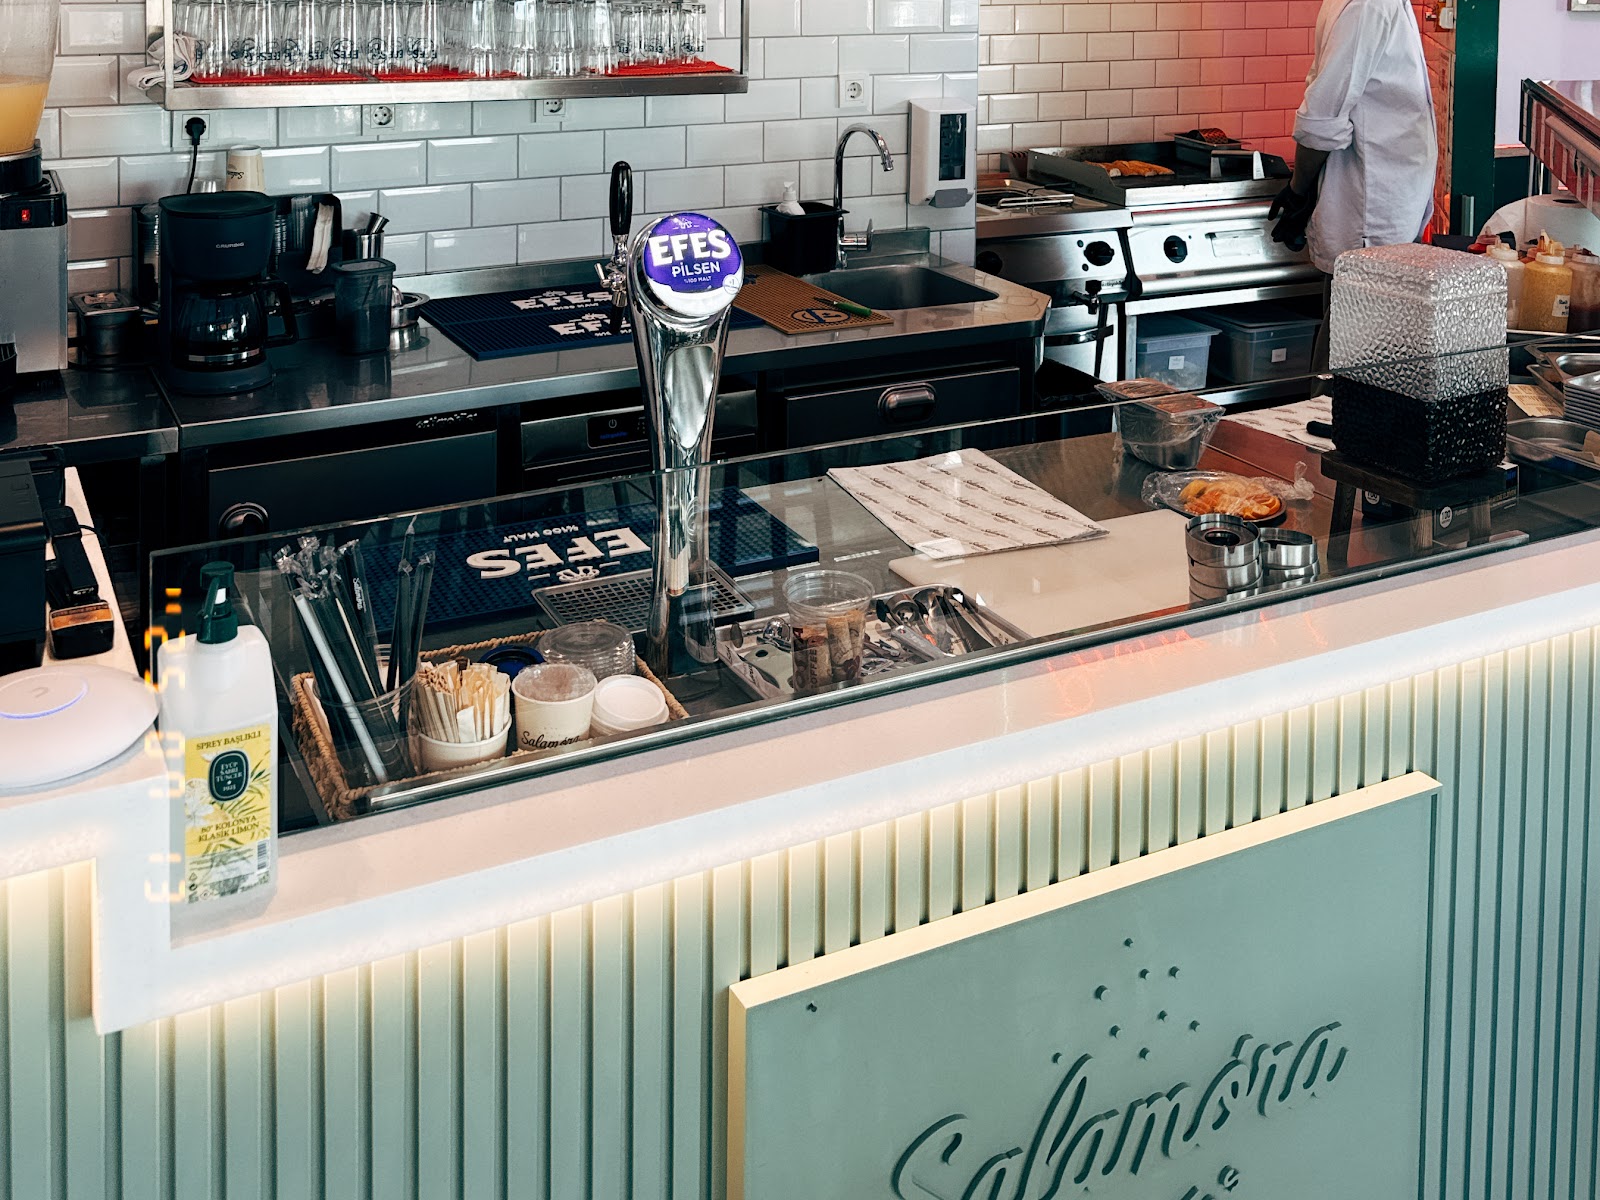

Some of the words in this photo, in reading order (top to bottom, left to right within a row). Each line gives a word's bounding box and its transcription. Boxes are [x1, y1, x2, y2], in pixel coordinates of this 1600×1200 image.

[649, 229, 731, 267] EFES
[671, 261, 720, 278] PİLSEN
[466, 527, 651, 580] EFES
[196, 738, 222, 751] SPREY
[223, 730, 262, 746] BAŞLIKLI
[215, 814, 257, 830] KOLONYA
